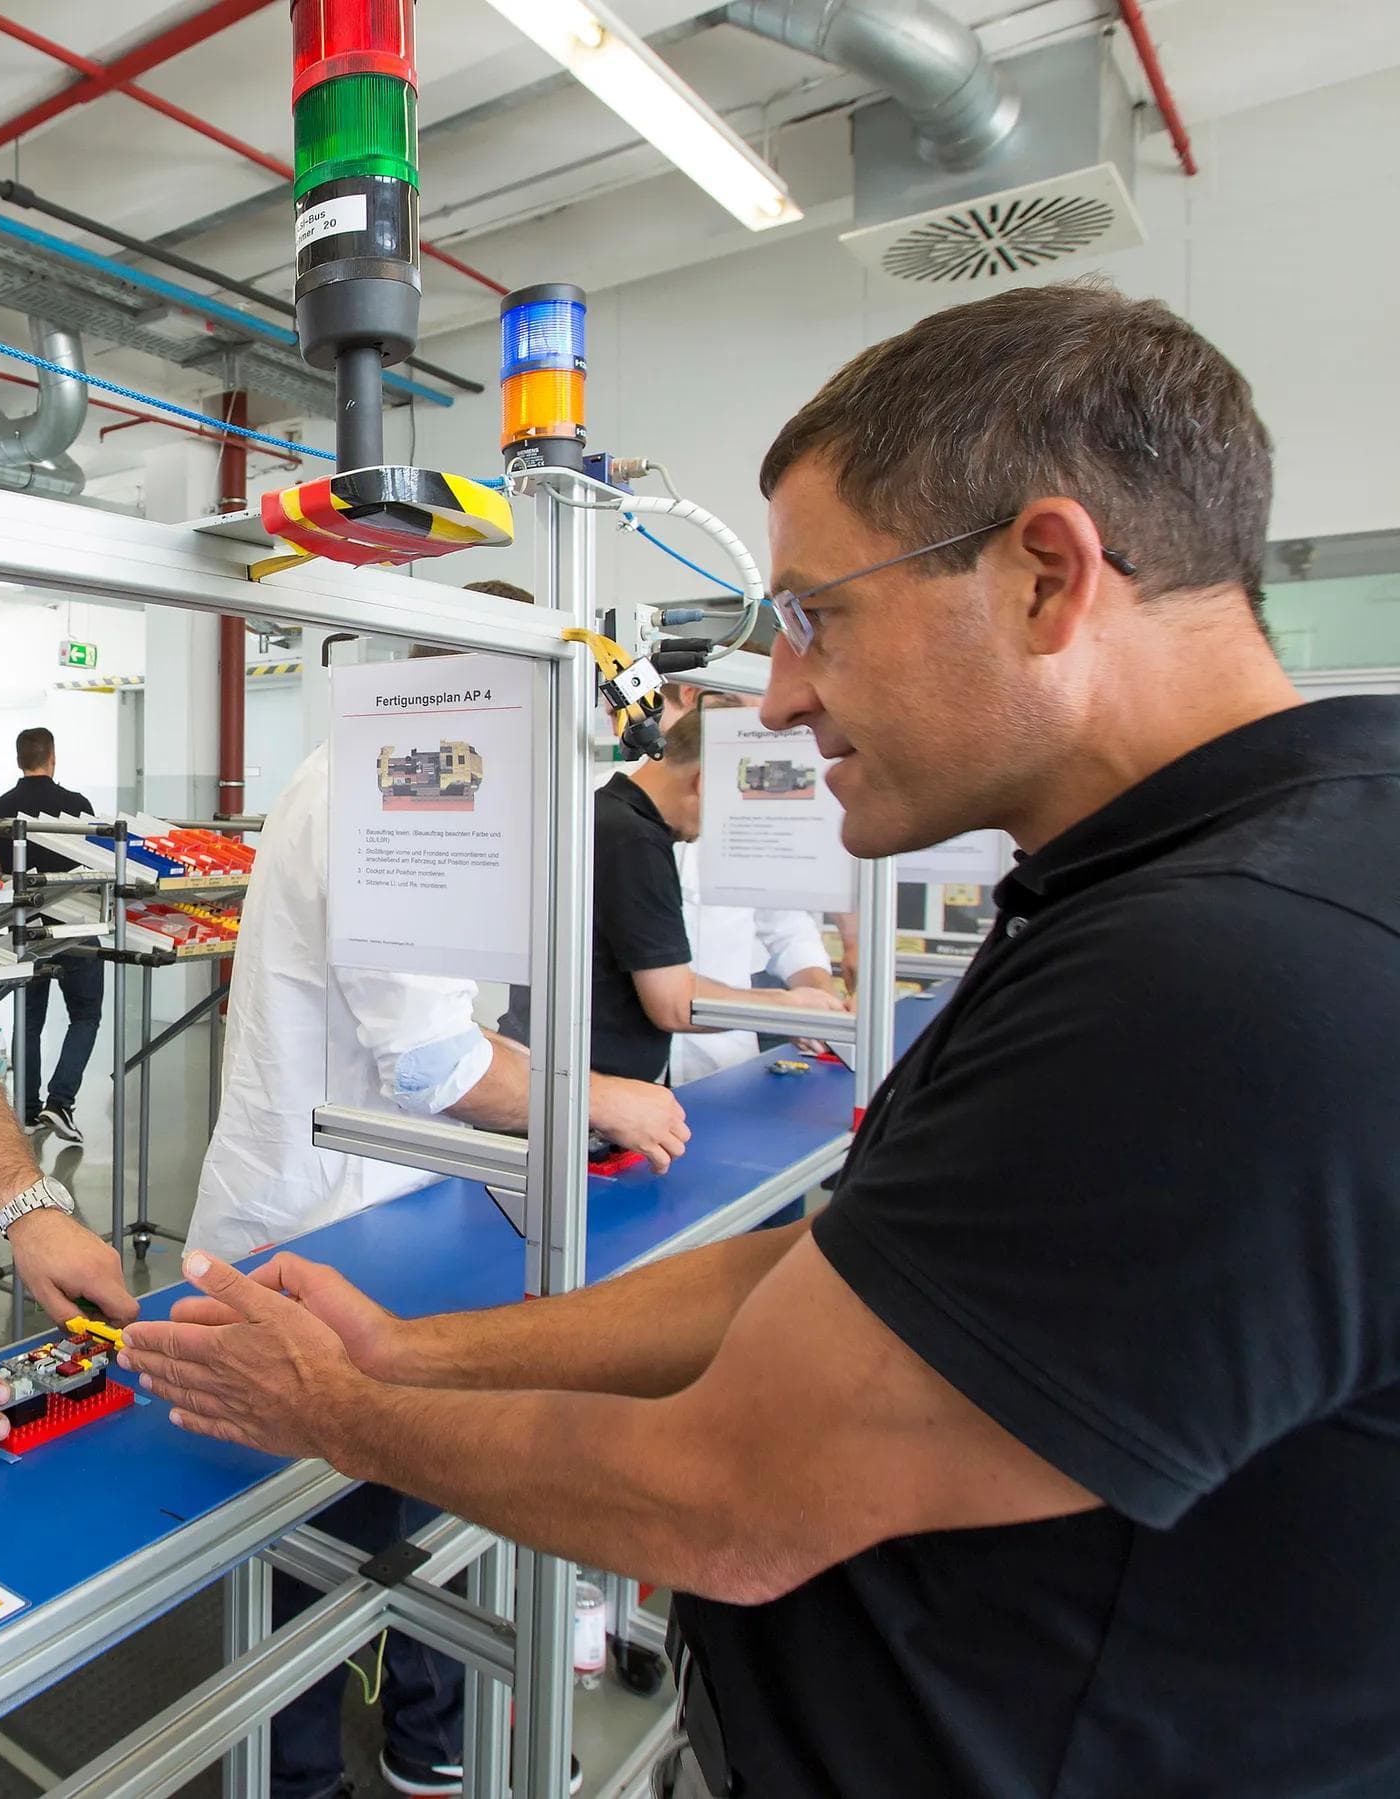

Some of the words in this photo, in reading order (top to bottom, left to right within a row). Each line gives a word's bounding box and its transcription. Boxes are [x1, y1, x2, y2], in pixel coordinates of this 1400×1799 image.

[323, 218, 337, 230] 20
[376, 692, 461, 708] Fertigungsplan
[463, 690, 481, 702] AP
[484, 689, 492, 701] 4
[410, 857, 437, 865] Fahrzeug
[365, 867, 385, 875] Cockpit
